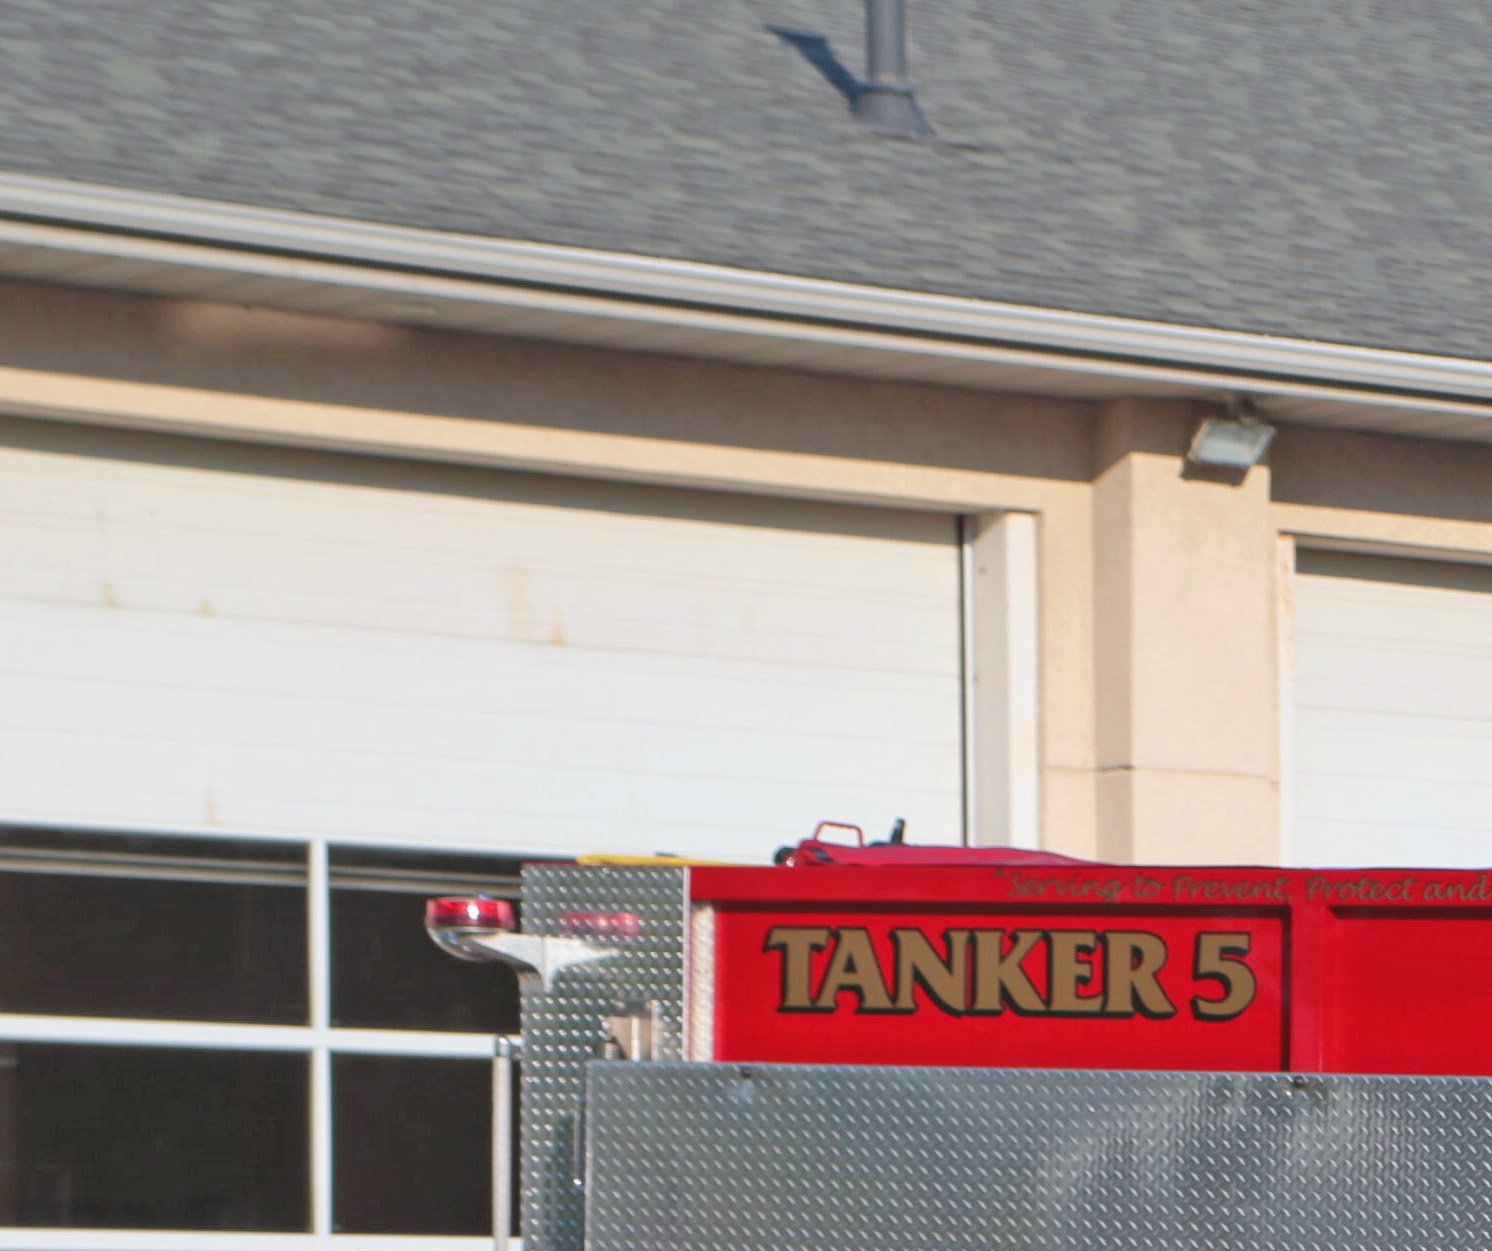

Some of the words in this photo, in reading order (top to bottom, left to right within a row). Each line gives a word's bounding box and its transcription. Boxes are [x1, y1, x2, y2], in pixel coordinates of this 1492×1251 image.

[1132, 873, 1167, 898] to
[1305, 874, 1419, 901] Protect
[764, 927, 1175, 1017] TANKER
[1190, 931, 1259, 1022] 5
